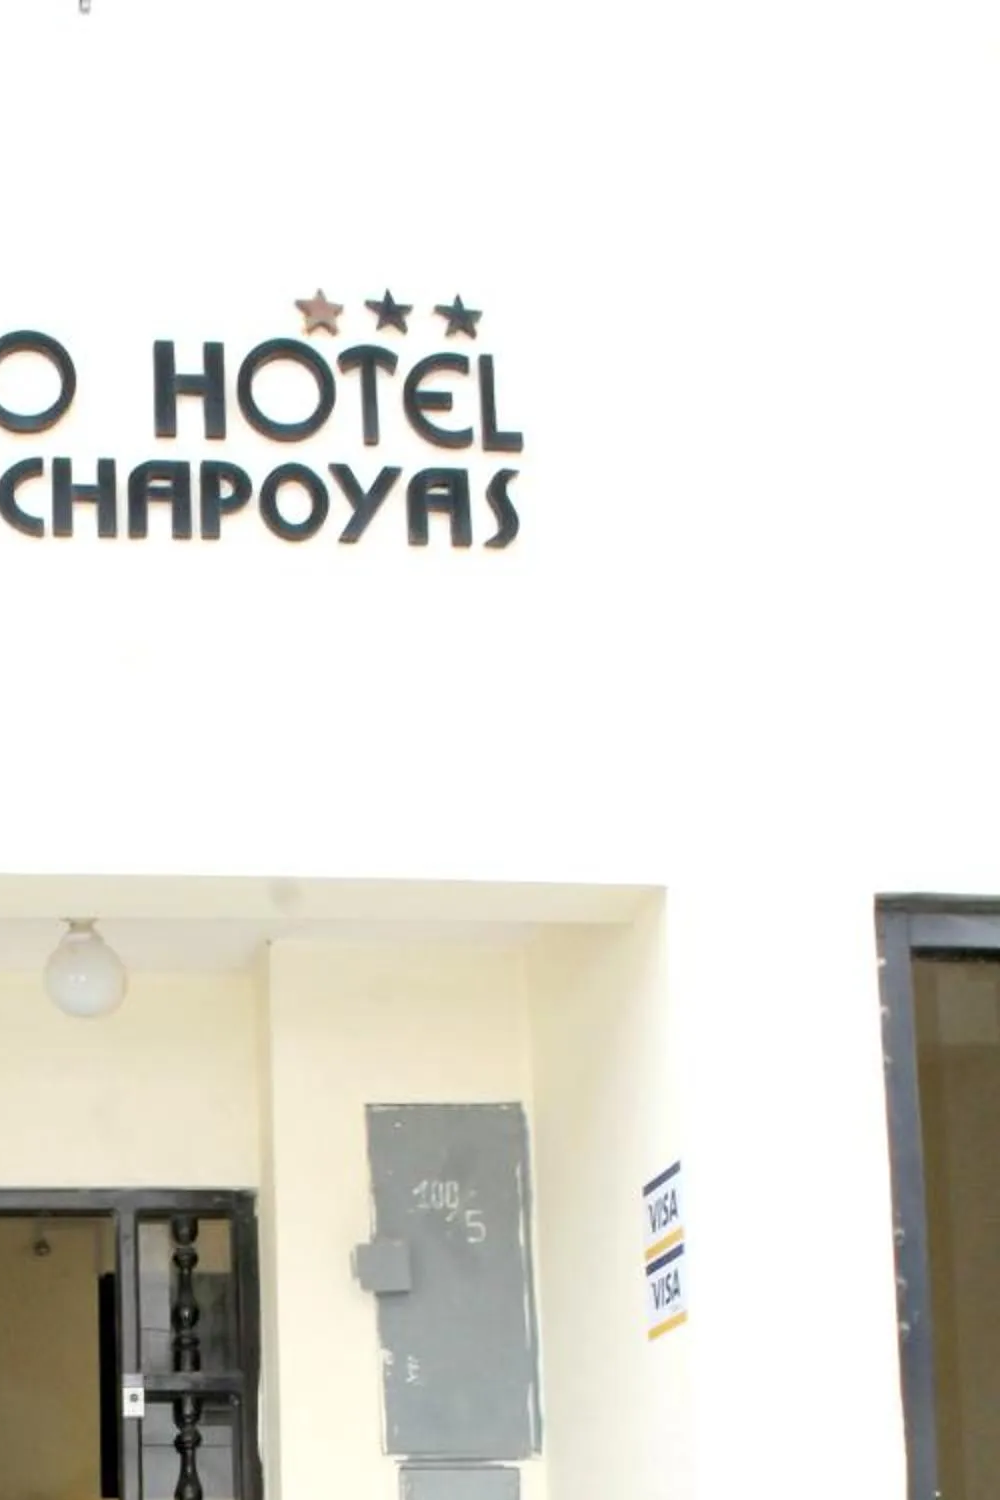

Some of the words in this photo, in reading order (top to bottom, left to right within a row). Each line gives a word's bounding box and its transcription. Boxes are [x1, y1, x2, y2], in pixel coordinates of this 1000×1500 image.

[152, 337, 524, 452] HOTEL
[647, 1187, 679, 1234] VISA
[651, 1267, 682, 1312] VISA
